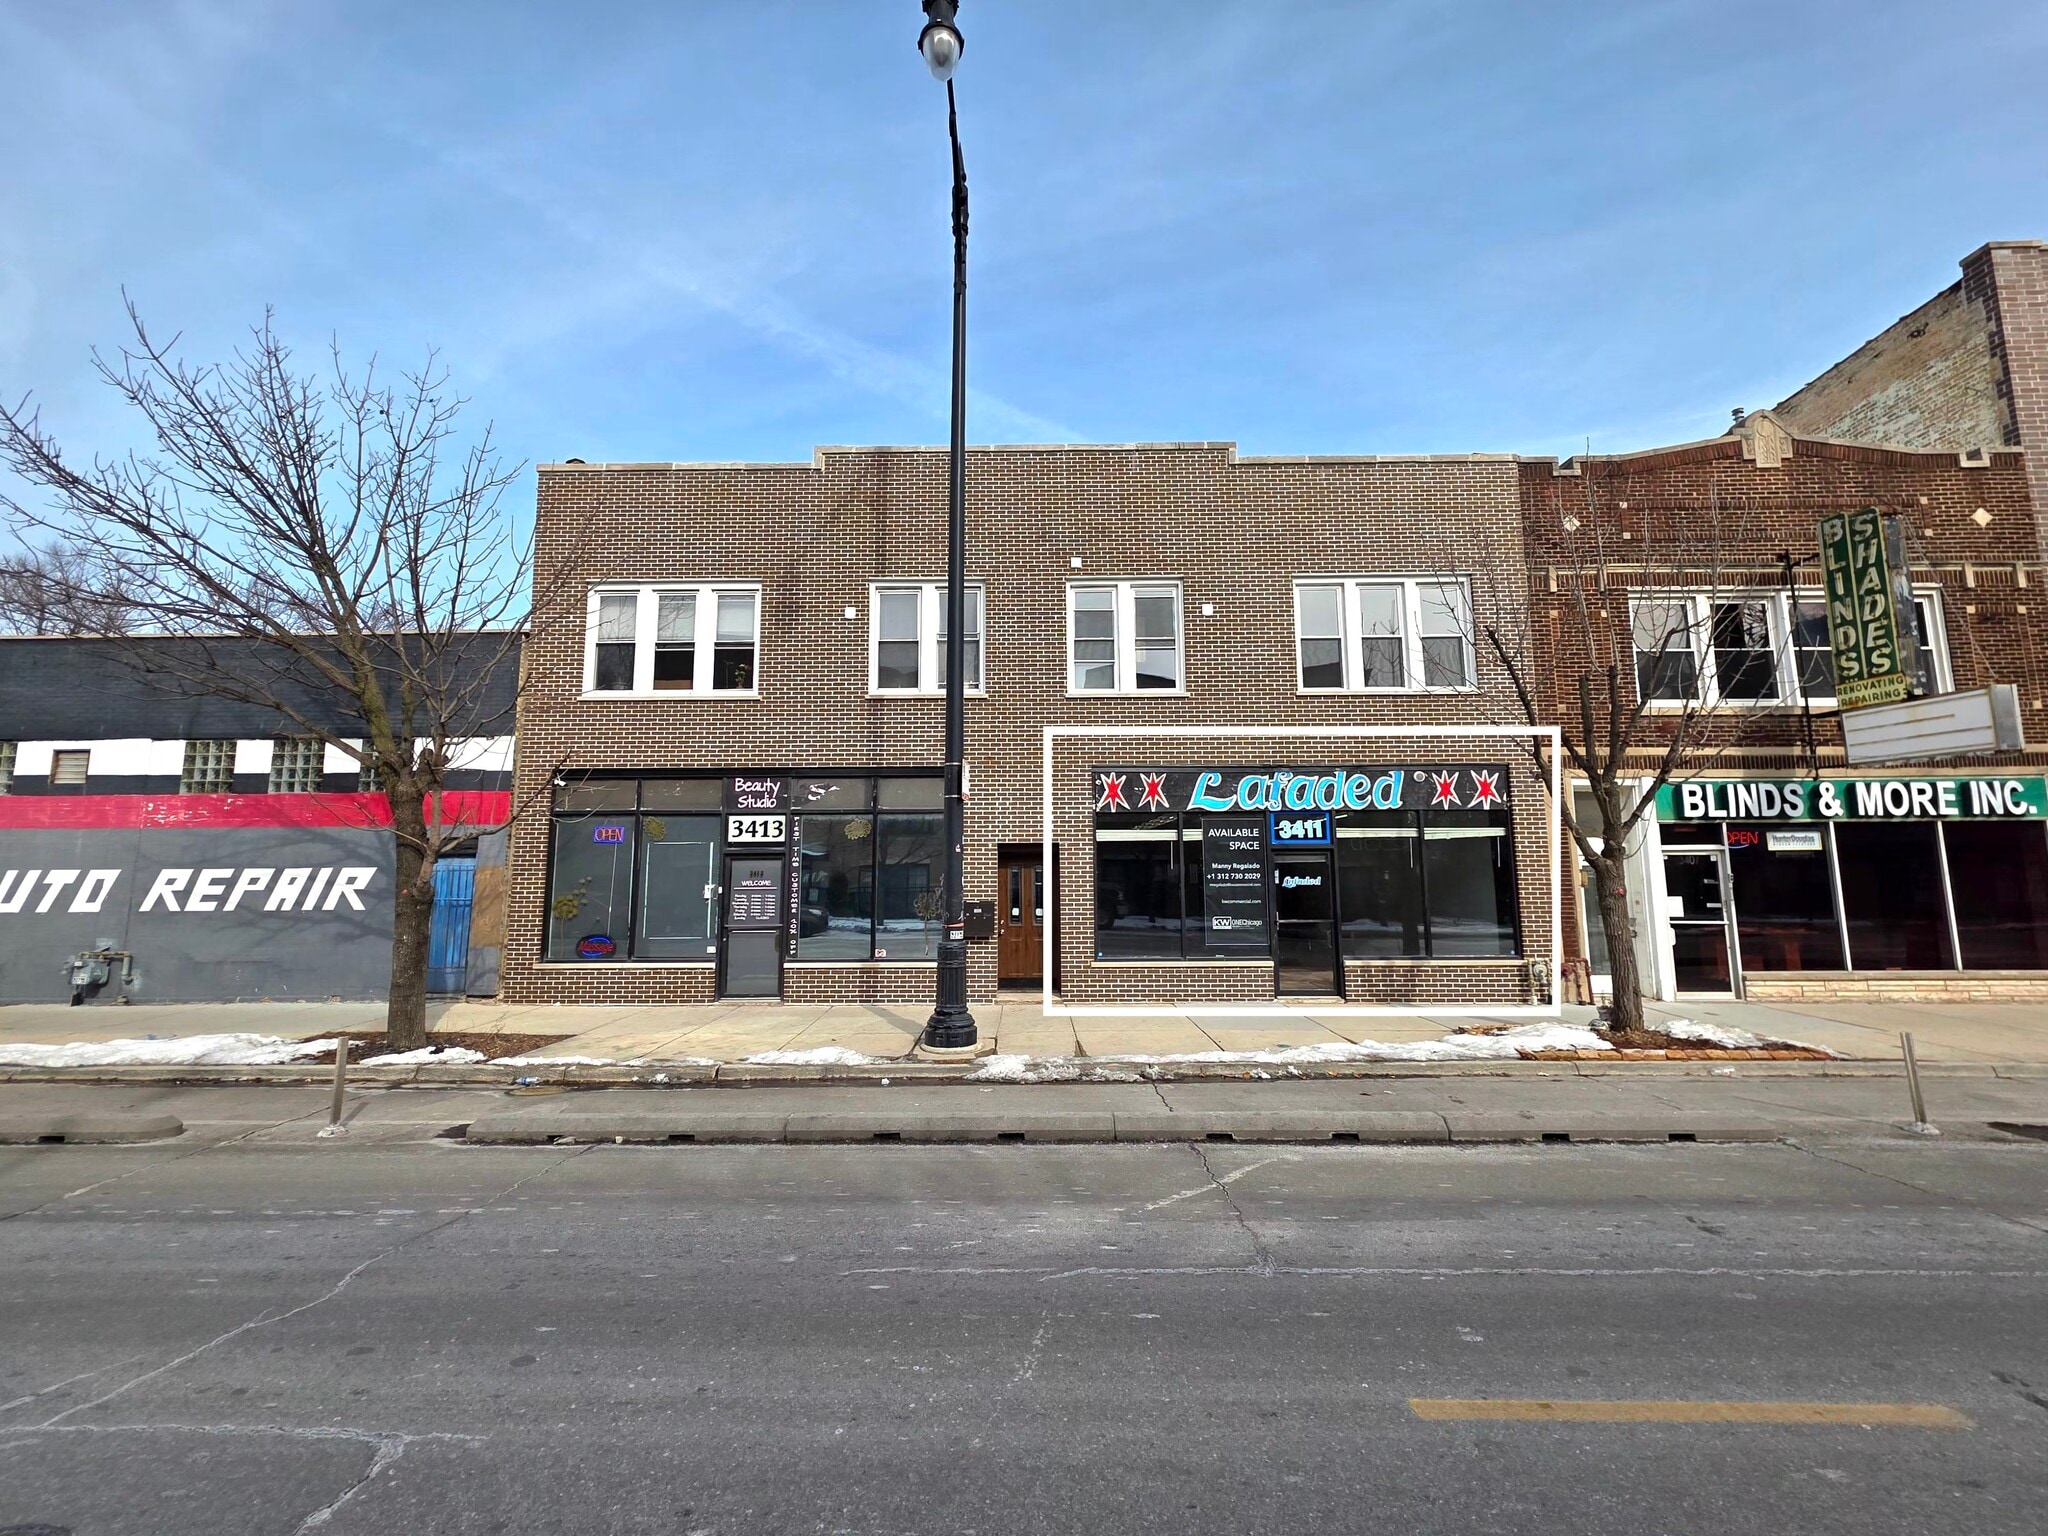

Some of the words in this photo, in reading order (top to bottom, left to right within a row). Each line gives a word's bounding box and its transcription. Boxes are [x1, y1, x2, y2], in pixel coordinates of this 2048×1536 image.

[1822, 518, 1860, 676] BLINDS
[1851, 513, 1893, 675] SHADES
[1837, 675, 1904, 697] RENOVATING
[1841, 688, 1901, 708] REPAIRING
[735, 777, 781, 798] Beauty
[1187, 770, 1404, 812] Lafaded
[737, 792, 777, 808] Studio
[1681, 782, 1805, 818] BLINDS
[1818, 781, 1844, 817] &
[1855, 781, 1959, 817] MORE
[1969, 780, 2038, 815] INC.
[595, 828, 622, 841] OPEN
[731, 819, 784, 838] 3413
[792, 816, 800, 841] FIRST
[1208, 828, 1260, 837] AVAILABLE
[1278, 819, 1323, 839] 3411
[1229, 841, 1260, 850] SPACE
[791, 846, 800, 868] TIME
[138, 866, 378, 912] REPAIR
[790, 872, 799, 914] CUSTOMER
[789, 918, 798, 935] 10%
[789, 939, 797, 955] OFF
